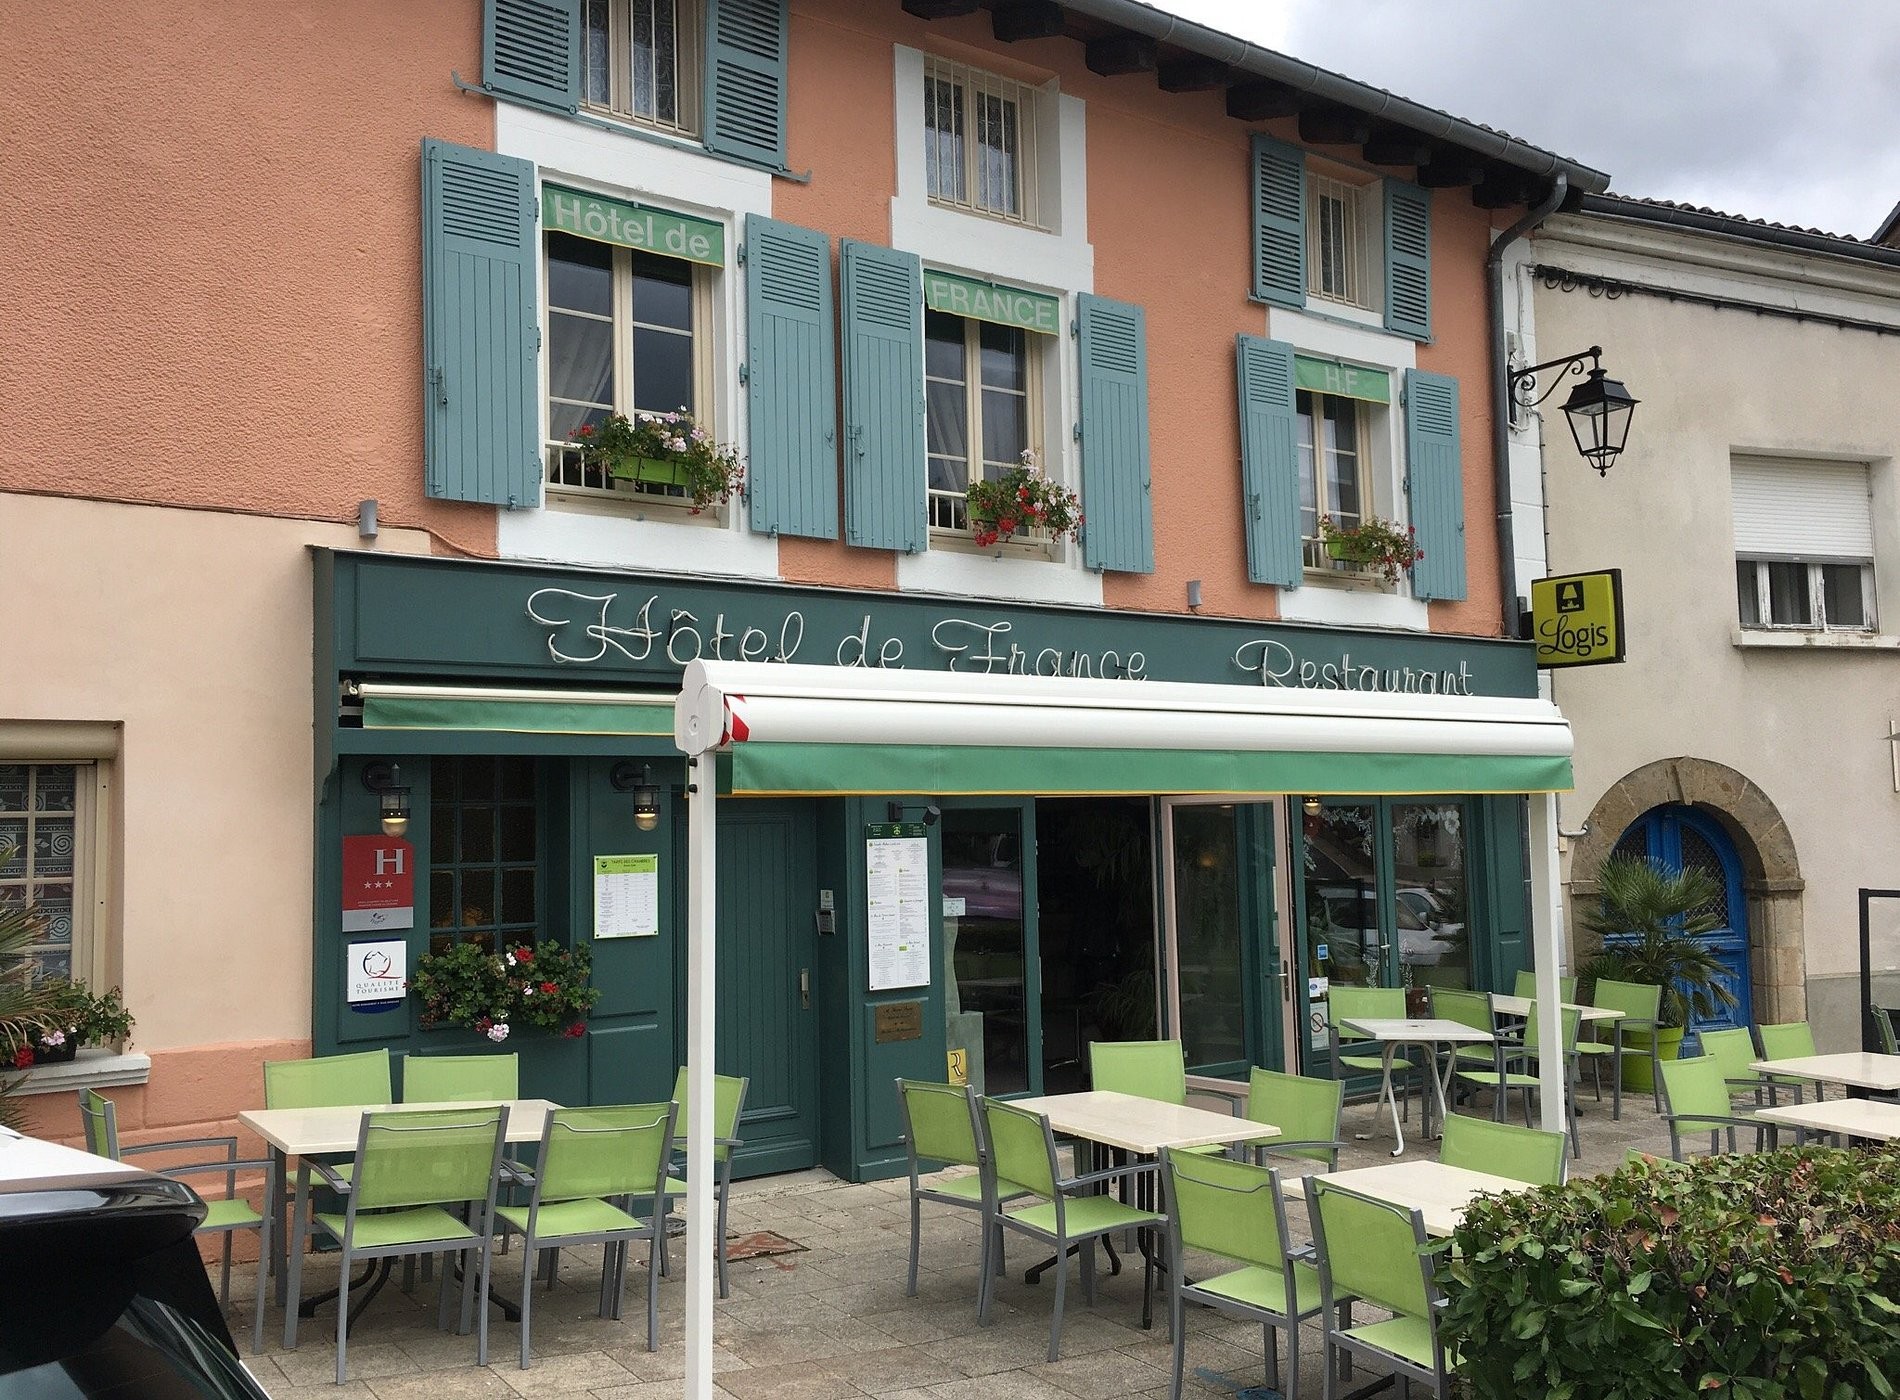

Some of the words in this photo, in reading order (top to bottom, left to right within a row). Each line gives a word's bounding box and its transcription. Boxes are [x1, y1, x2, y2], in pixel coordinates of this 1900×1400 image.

[554, 194, 654, 248] Hôtel
[665, 223, 711, 258] de
[931, 279, 1053, 329] FRANCE
[526, 587, 805, 665] Hôtel
[836, 614, 904, 670] de
[931, 618, 1148, 682] France
[1538, 614, 1609, 657] Logis
[1231, 639, 1474, 696] Restaurant
[373, 848, 407, 876] H
[356, 986, 400, 995] TOURISME
